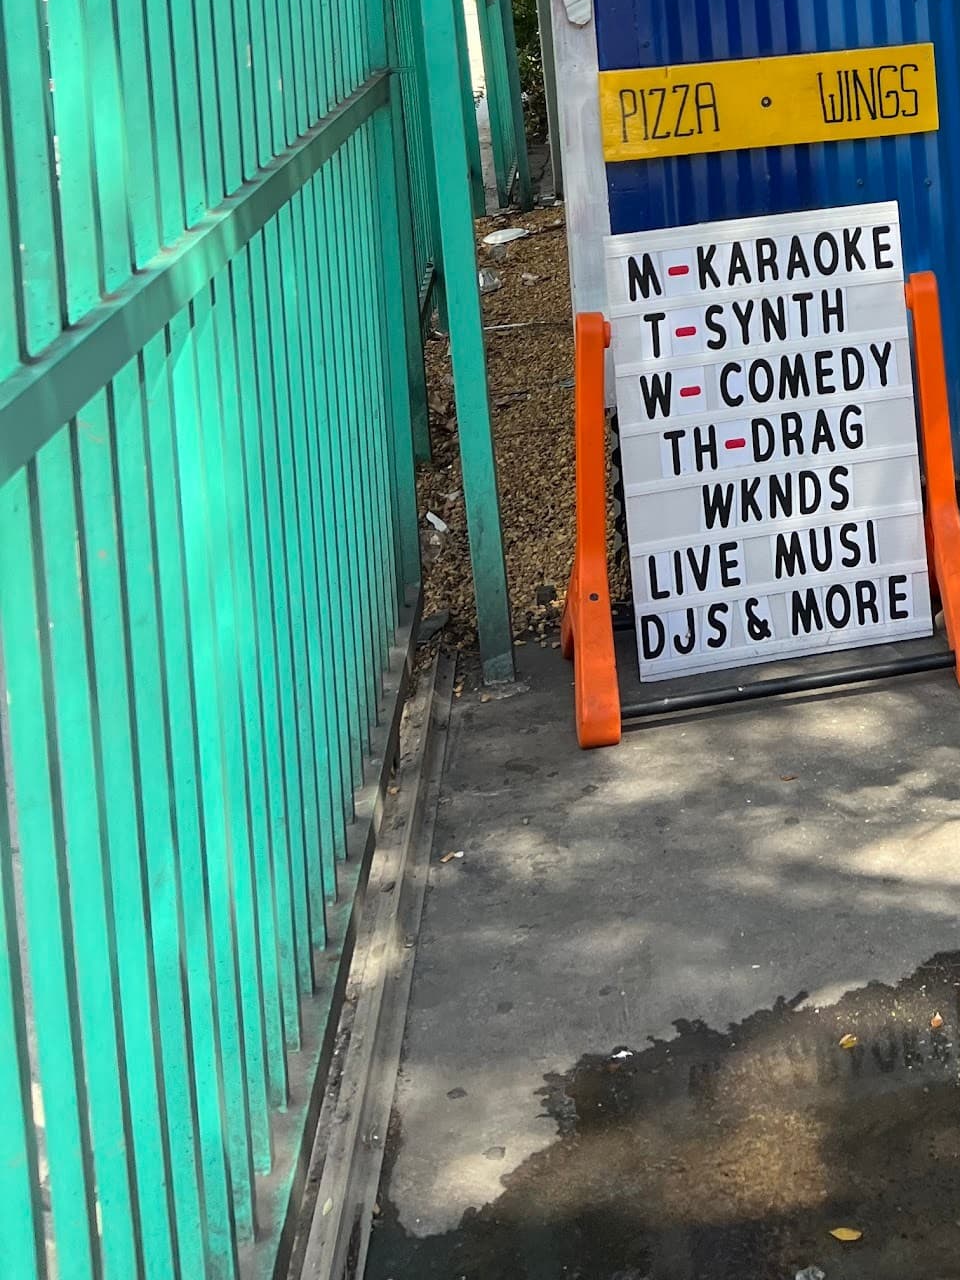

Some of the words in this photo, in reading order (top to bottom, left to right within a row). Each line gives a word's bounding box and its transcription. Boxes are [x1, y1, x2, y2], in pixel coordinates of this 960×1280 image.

[618, 81, 720, 143] PIZZA
[816, 63, 920, 124] WINGS
[719, 341, 893, 408] COMEDY
[702, 465, 850, 529] WKNDS
[647, 540, 742, 601] LIVE
[773, 519, 878, 579] MUSI
[792, 574, 909, 636] MORE
